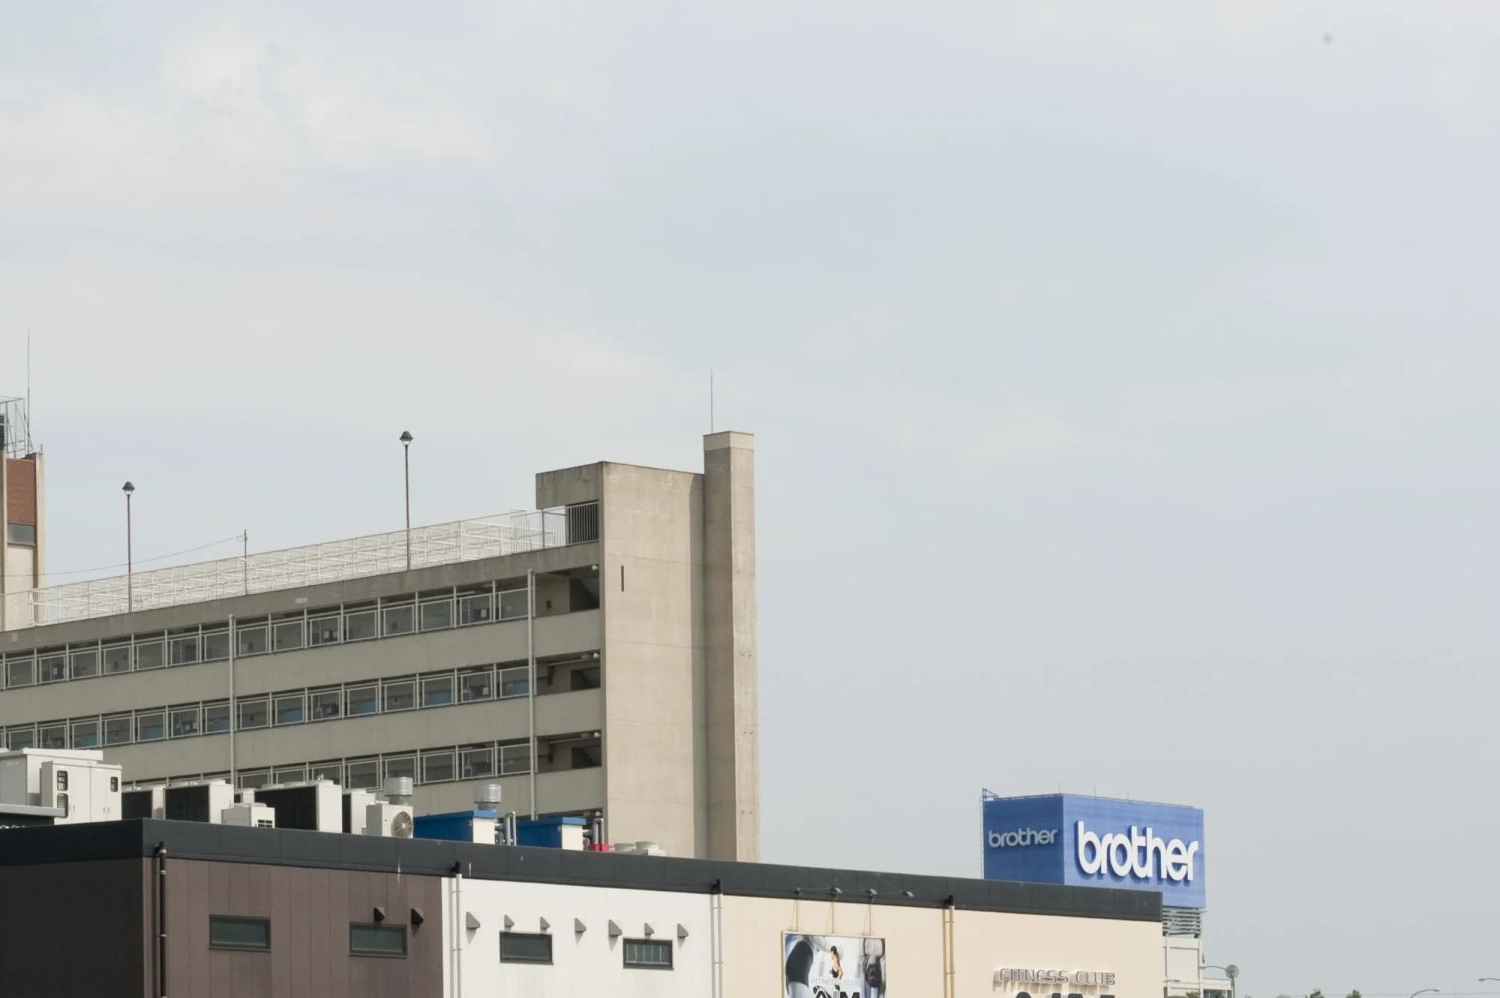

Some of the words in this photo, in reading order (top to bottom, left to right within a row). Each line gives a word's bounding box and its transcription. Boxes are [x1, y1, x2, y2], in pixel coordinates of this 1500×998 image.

[988, 827, 1058, 848] brother
[1077, 820, 1199, 882] brother
[999, 967, 1069, 984] FITNESS
[1075, 970, 1116, 986] CLUB
